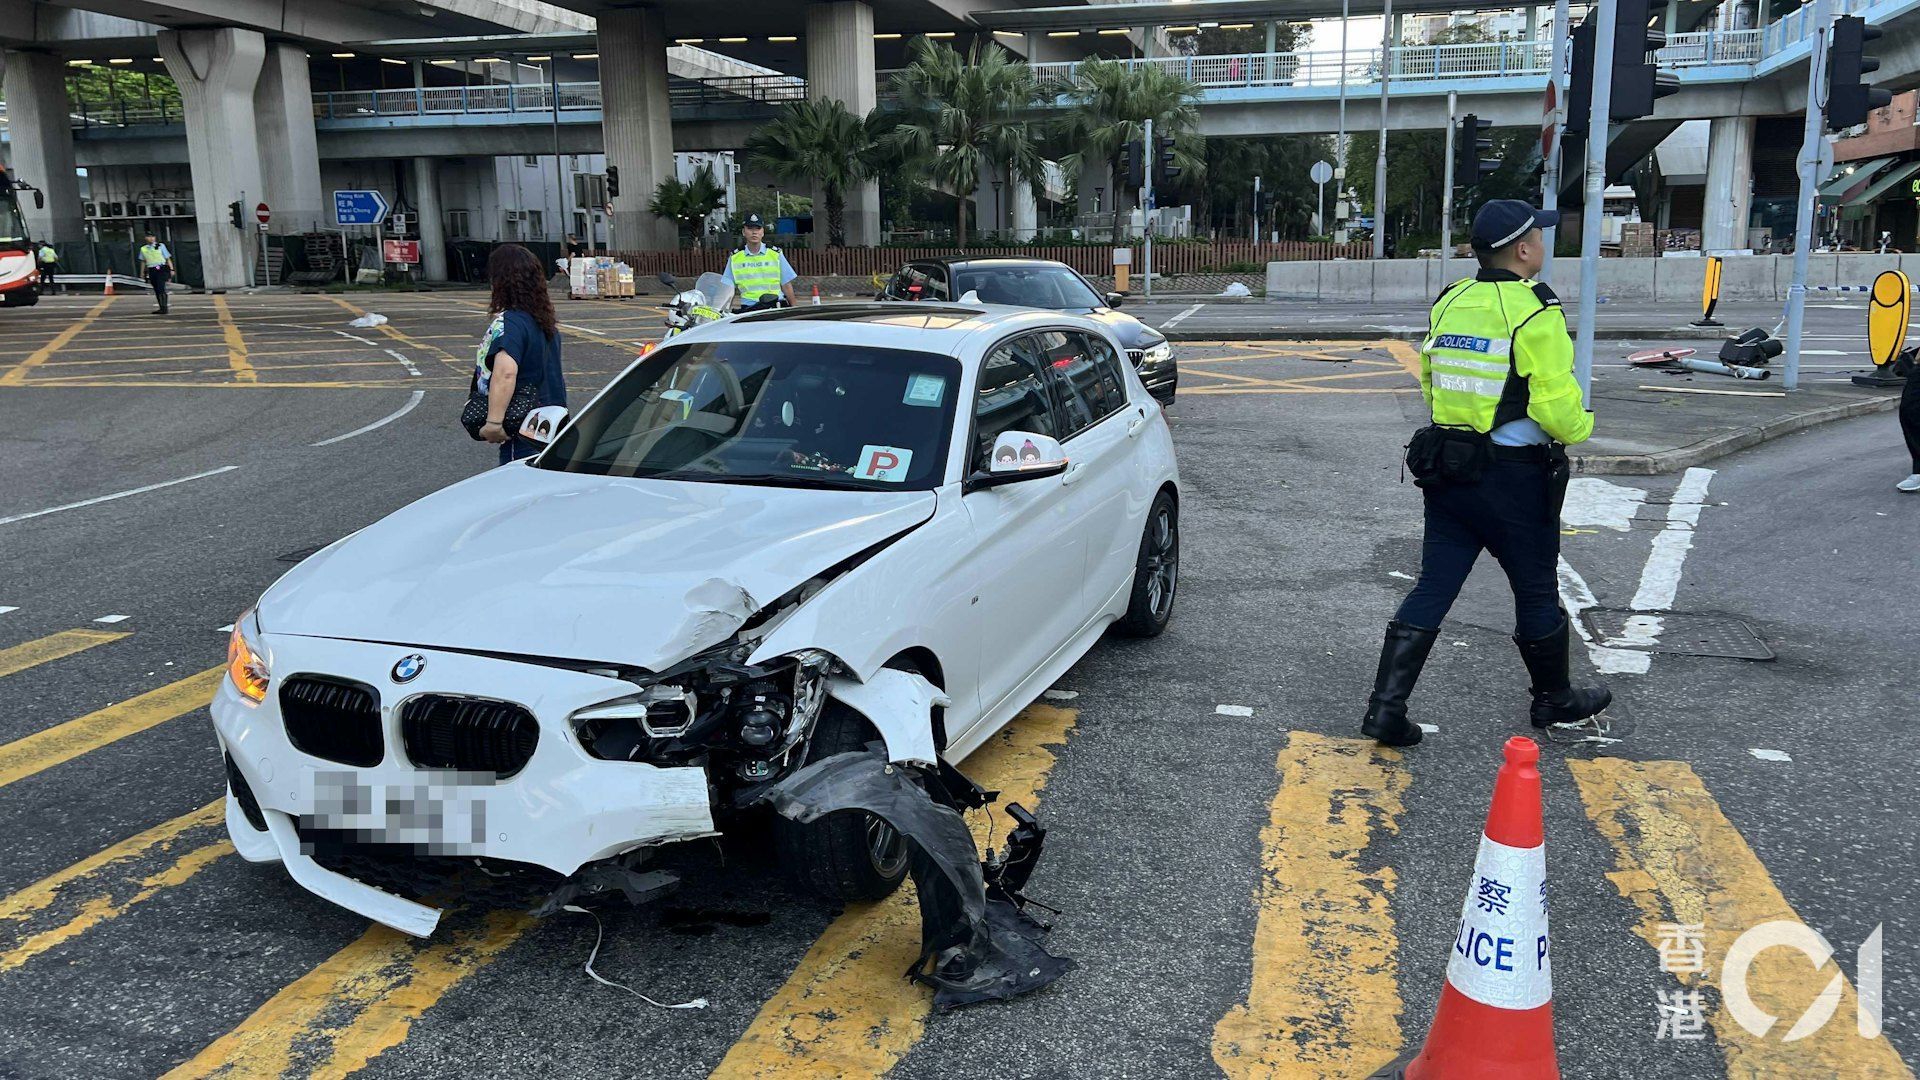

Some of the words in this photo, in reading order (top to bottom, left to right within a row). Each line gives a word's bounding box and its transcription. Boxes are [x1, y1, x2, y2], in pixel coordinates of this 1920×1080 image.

[1439, 336, 1473, 349] POLICE
[1475, 339, 1487, 351] 察
[866, 451, 899, 476] P
[1477, 876, 1512, 916] 察
[1455, 919, 1515, 972] LICE
